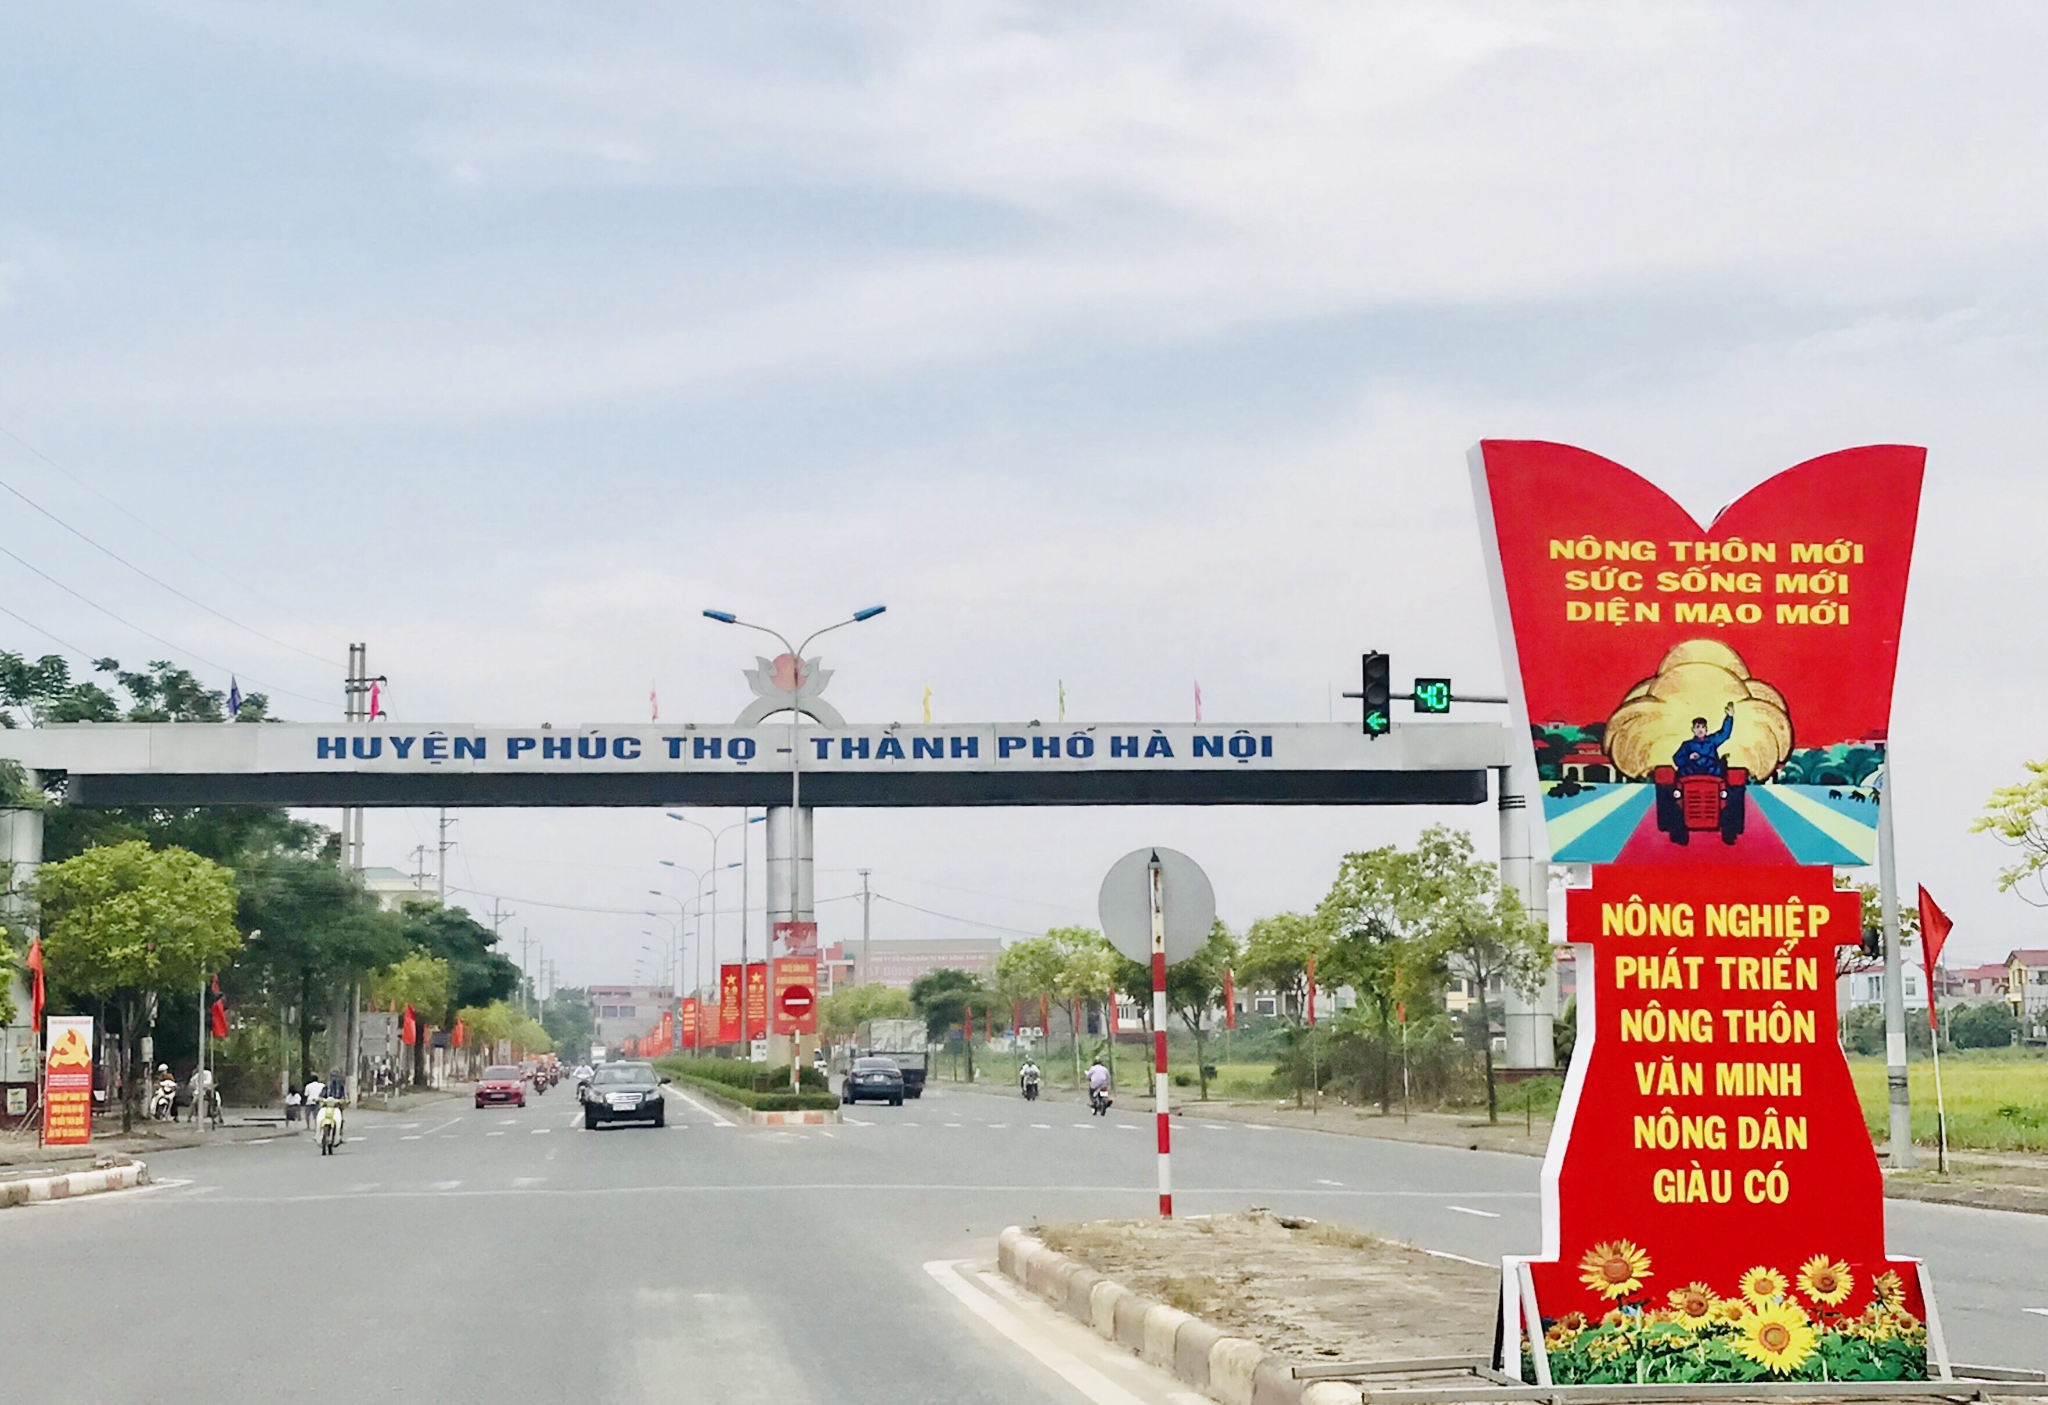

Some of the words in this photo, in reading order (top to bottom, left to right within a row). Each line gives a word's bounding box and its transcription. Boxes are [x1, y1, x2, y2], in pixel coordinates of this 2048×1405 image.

[1550, 535, 1656, 562] NÔNG
[1669, 537, 1776, 563] THÔN
[1791, 538, 1864, 564] MỚI
[1565, 566, 1643, 592] SỨC
[1657, 565, 1762, 594] SỐNG
[1776, 568, 1849, 595] MỚI
[1566, 597, 1660, 627] DIỆN
[1675, 602, 1762, 628] MẠO
[1777, 599, 1850, 625] MỚI
[1416, 682, 1448, 709] 40
[317, 731, 487, 765] HUYỆN
[507, 730, 641, 760] PHÚC
[662, 737, 756, 765] THỌ
[810, 730, 979, 760] THÀNH
[998, 726, 1095, 759] PHỐ
[1110, 729, 1175, 758] HÀ
[1192, 729, 1273, 764] NỘI
[1601, 895, 1694, 937] NÔNG
[1705, 896, 1830, 938] NGHIỆP
[1615, 947, 1705, 990] PHÁT
[1714, 938, 1818, 991] TRIỂN
[1620, 1000, 1713, 1043] NÔNG
[1722, 1001, 1816, 1043] THÔN
[1634, 1055, 1704, 1096] VĂN
[1715, 1062, 1802, 1097] MINH
[1633, 1107, 1727, 1150] NÔNG
[1737, 1107, 1808, 1150] DÂN
[1653, 1160, 1732, 1204] GIÀU
[1743, 1161, 1790, 1204] CÓ
